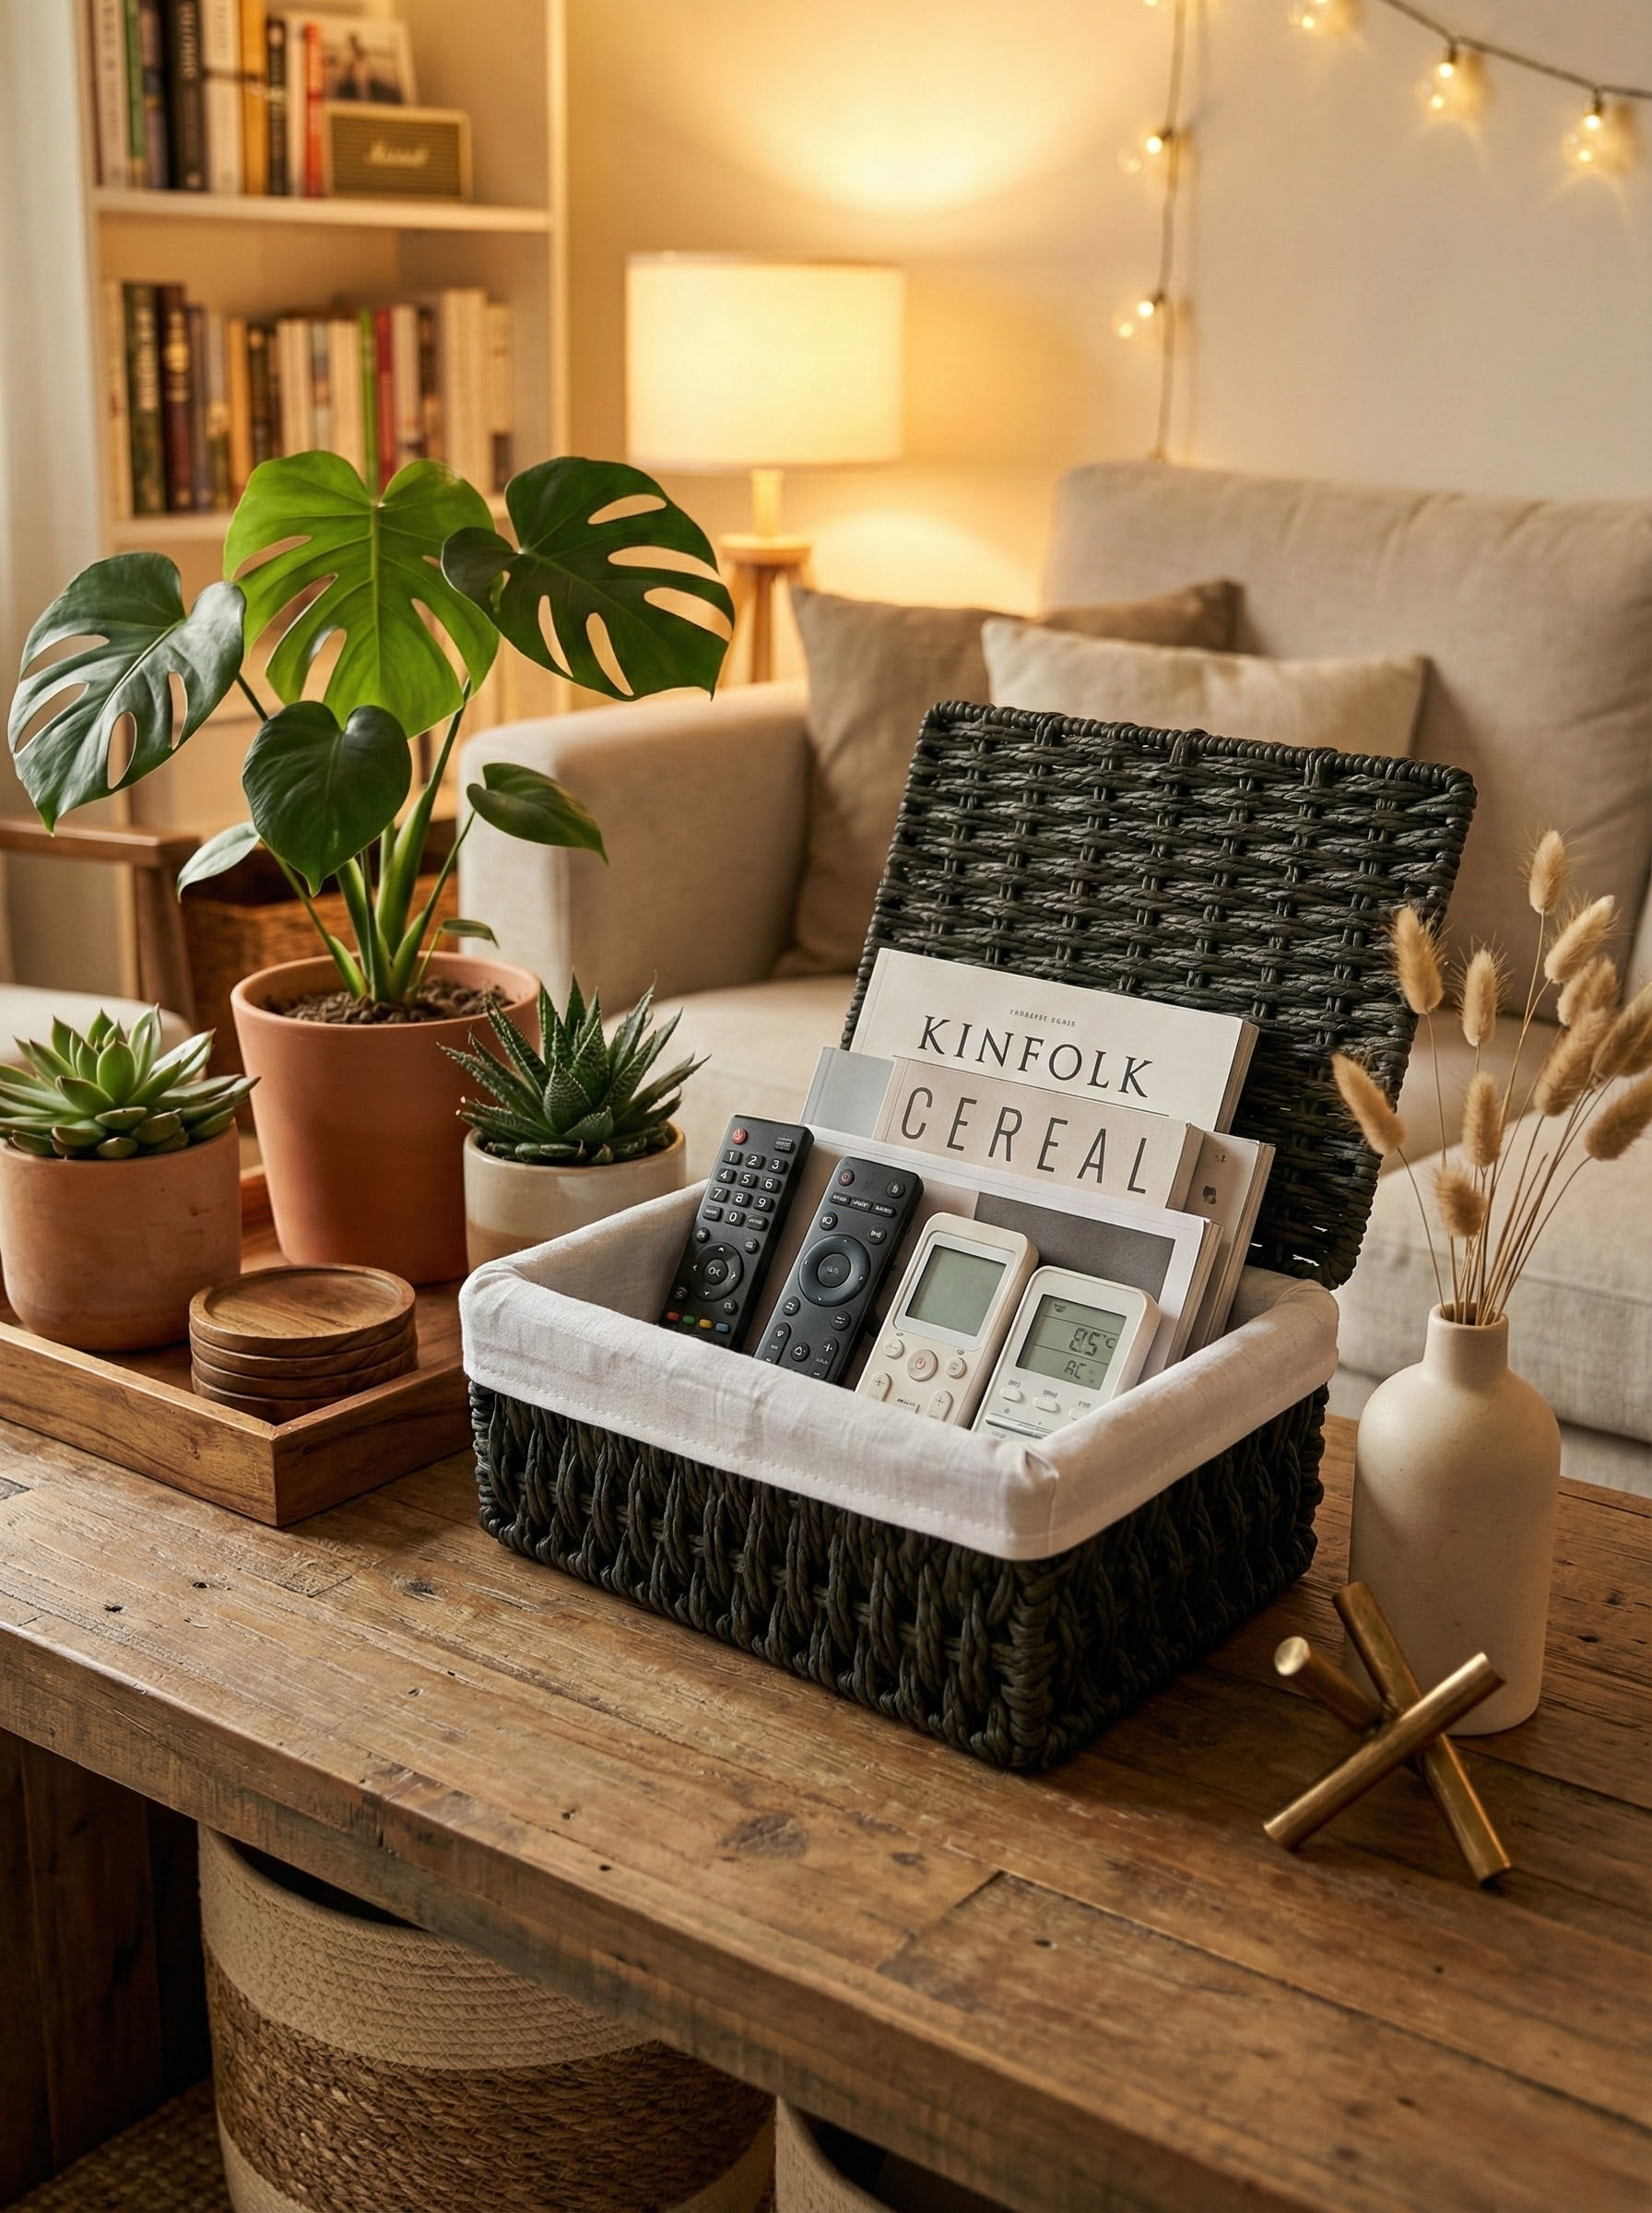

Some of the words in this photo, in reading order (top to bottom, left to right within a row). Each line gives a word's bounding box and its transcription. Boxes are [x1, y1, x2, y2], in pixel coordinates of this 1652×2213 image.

[917, 1014, 1153, 1098] KINFOLK
[901, 1086, 1148, 1194] CEREAL
[748, 1155, 758, 1166] 2
[772, 1159, 780, 1170] 3
[720, 1170, 728, 1179] 4
[741, 1174, 751, 1184] 5
[765, 1178, 773, 1189] 6
[714, 1188, 722, 1199] 7
[735, 1192, 744, 1203] 8
[758, 1198, 766, 1208] 9
[728, 1212, 738, 1222] 0
